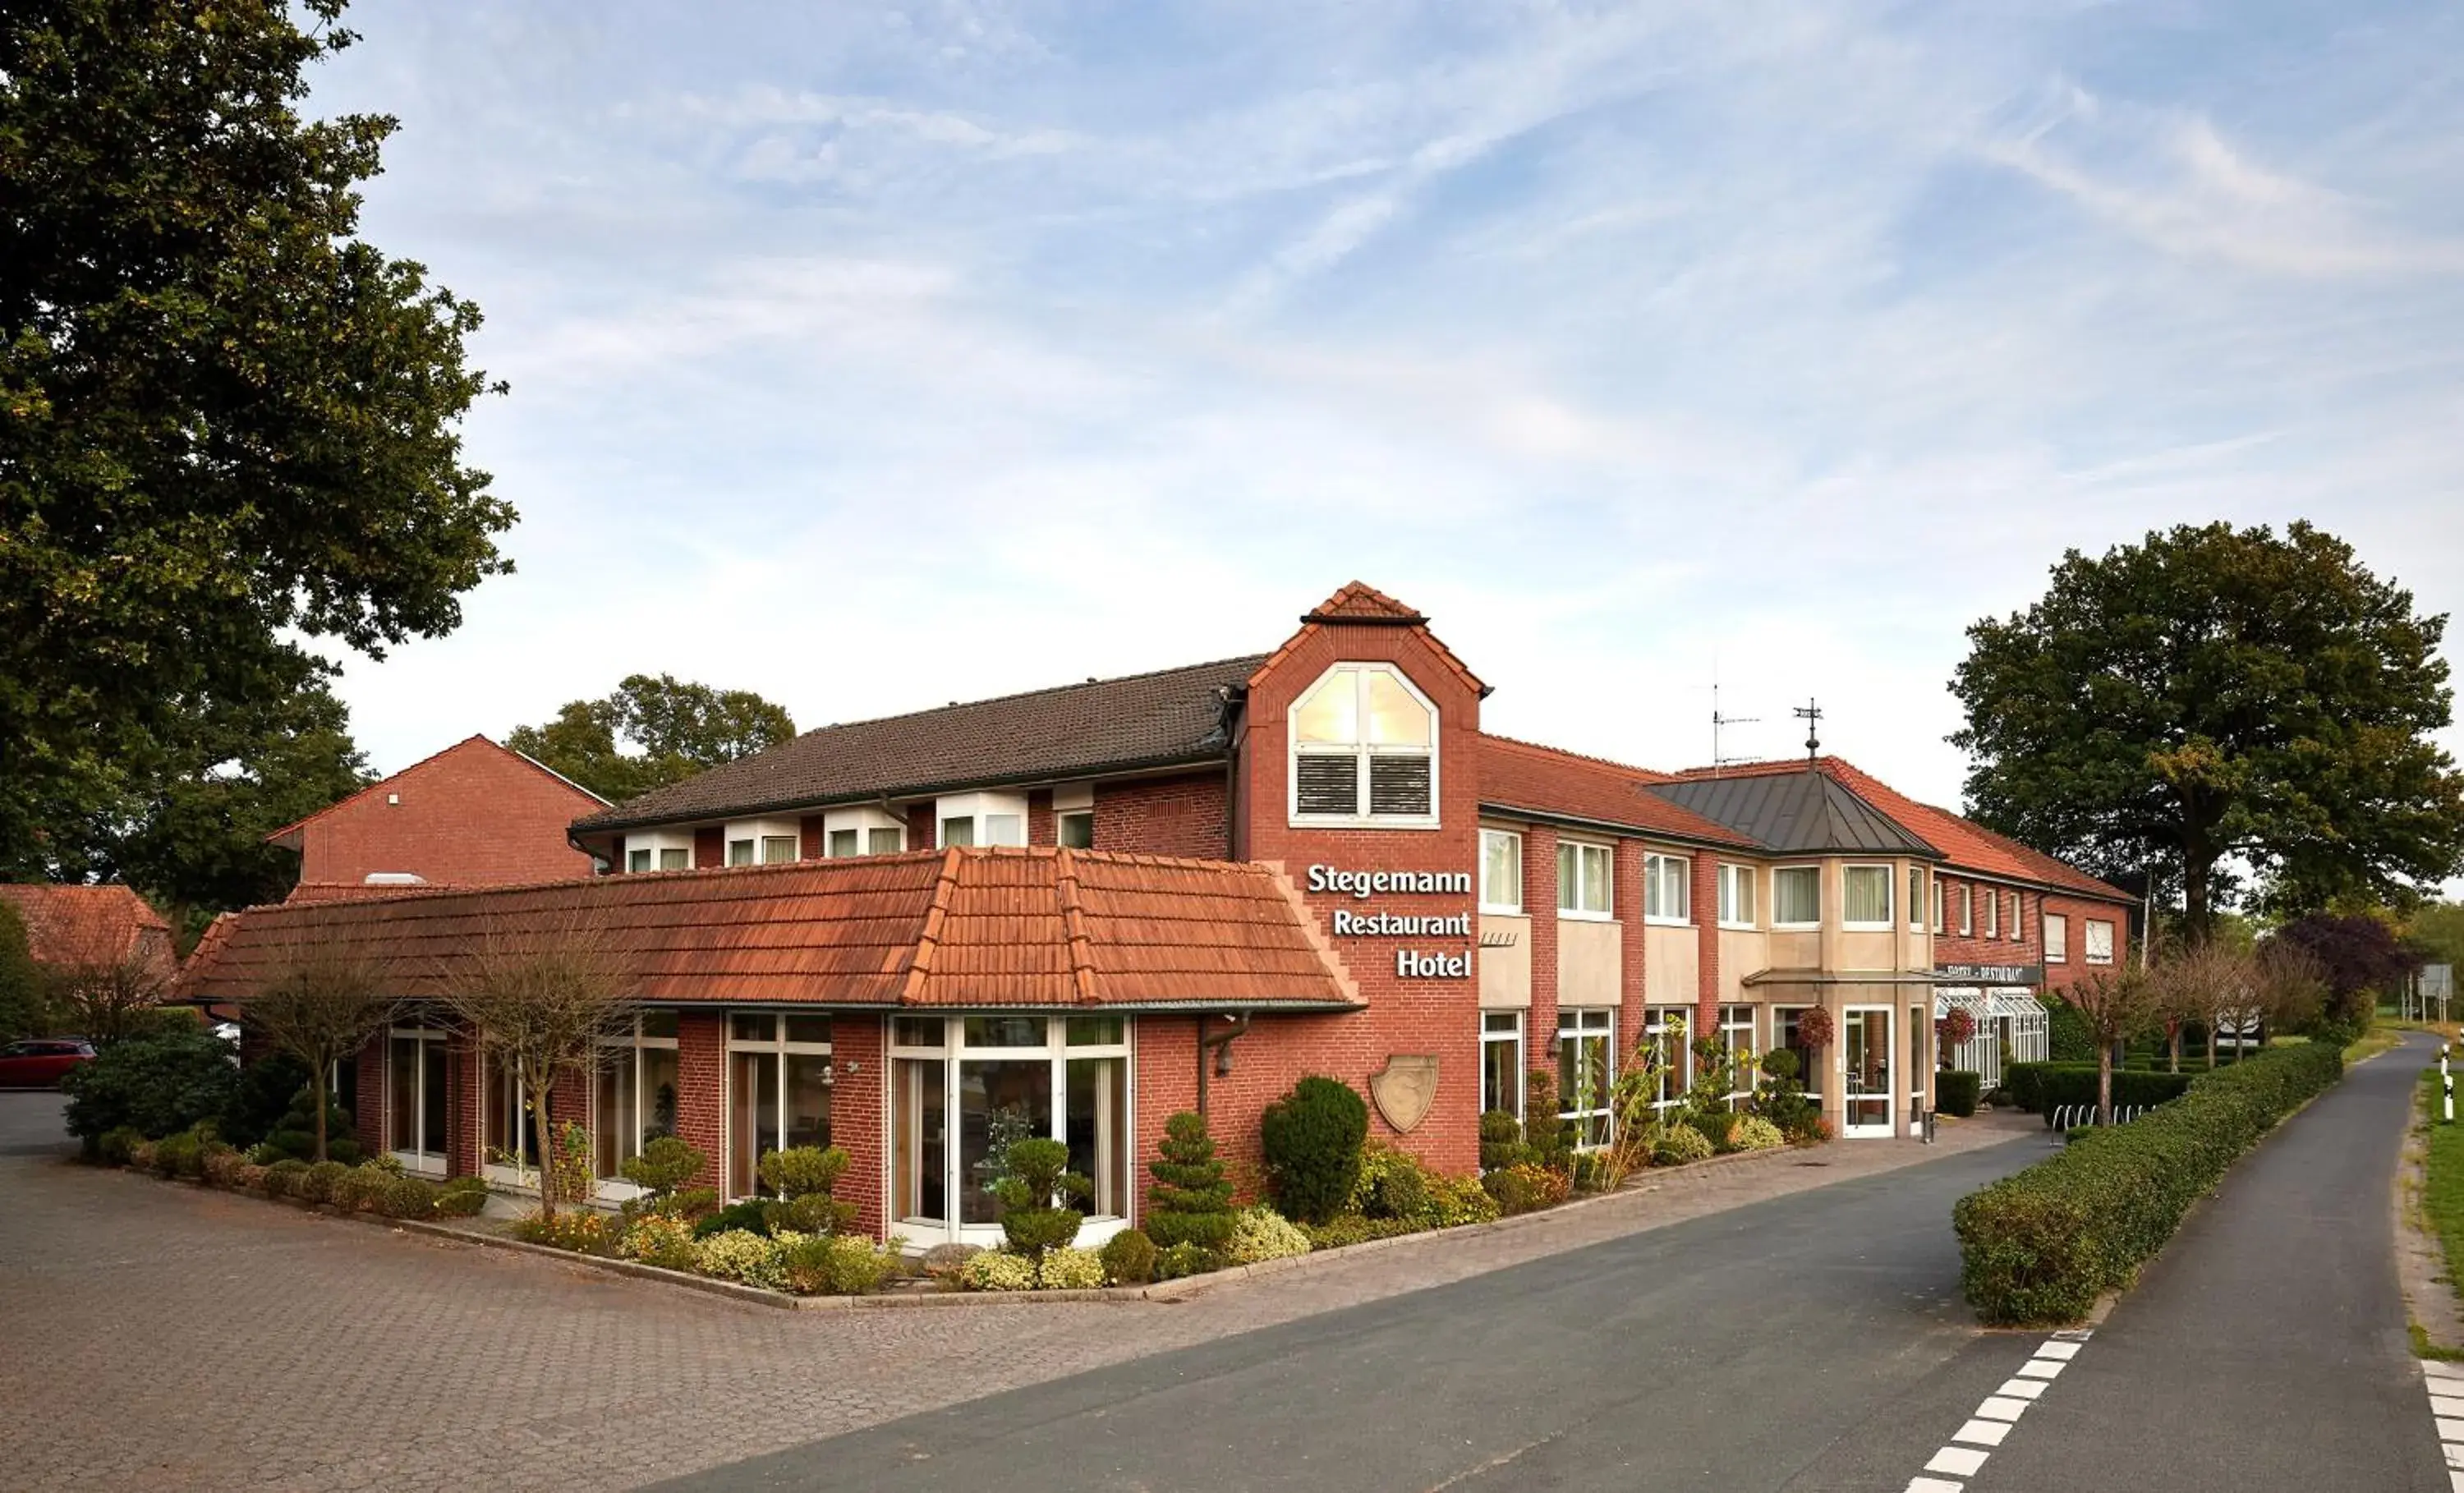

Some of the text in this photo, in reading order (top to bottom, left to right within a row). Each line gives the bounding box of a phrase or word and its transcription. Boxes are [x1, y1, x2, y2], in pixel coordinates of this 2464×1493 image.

[1308, 863, 1471, 898] Stegemann
[1335, 909, 1471, 935] Restaurant
[1398, 949, 1471, 976] Hotel
